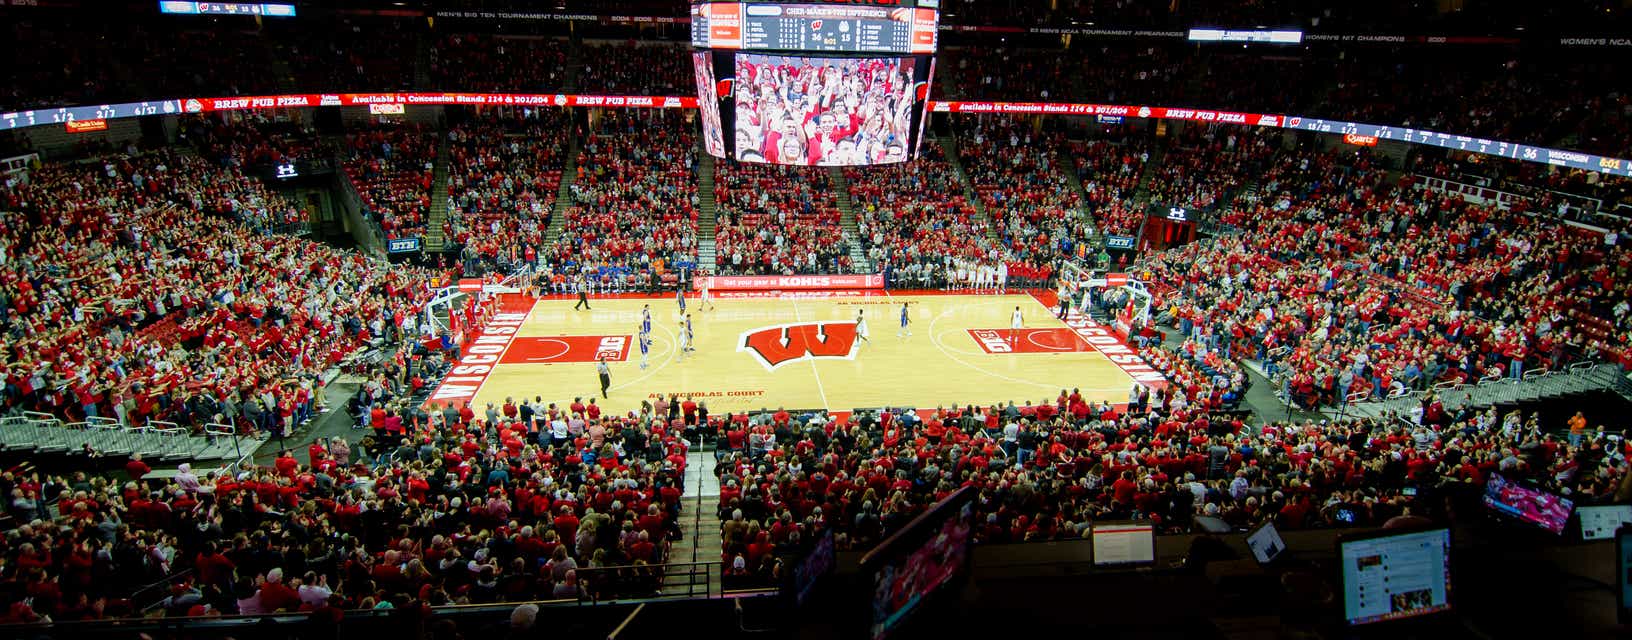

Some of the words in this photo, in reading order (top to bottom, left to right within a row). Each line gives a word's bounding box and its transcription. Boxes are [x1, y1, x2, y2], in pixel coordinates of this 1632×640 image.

[811, 33, 822, 41] 36
[841, 33, 851, 42] 15
[1560, 37, 1607, 46] WOMEN'S
[214, 98, 249, 109] BREW
[252, 97, 274, 107] PUB
[277, 96, 309, 106] PIZZA
[352, 95, 394, 103] Available
[397, 95, 406, 103] in
[408, 95, 455, 103] Concession
[457, 95, 485, 103] Stands
[488, 95, 503, 103] 114
[515, 96, 548, 104] 201/204
[576, 96, 605, 104] BREW
[605, 96, 625, 105] PUB
[627, 97, 653, 105] PIZZA
[959, 103, 993, 111] Available
[994, 103, 1002, 111] in
[1003, 103, 1043, 112] Concession
[1044, 104, 1069, 112] Stands
[1070, 104, 1084, 112] 114
[1096, 104, 1127, 114] 201/204
[1165, 109, 1194, 119] BREW
[1195, 111, 1215, 120] PUB
[1216, 112, 1246, 122] PIZZA
[1347, 134, 1374, 143] Quartz
[1523, 148, 1537, 159] 36
[1548, 150, 1589, 163] WISCONSIN
[391, 241, 415, 250] BTN
[1108, 238, 1130, 246] BTN
[737, 279, 752, 288] your
[754, 280, 769, 288] gear
[779, 277, 830, 286] KOHL'S
[1051, 306, 1168, 382] WISCONSIN
[432, 313, 528, 400] WISCONSIN
